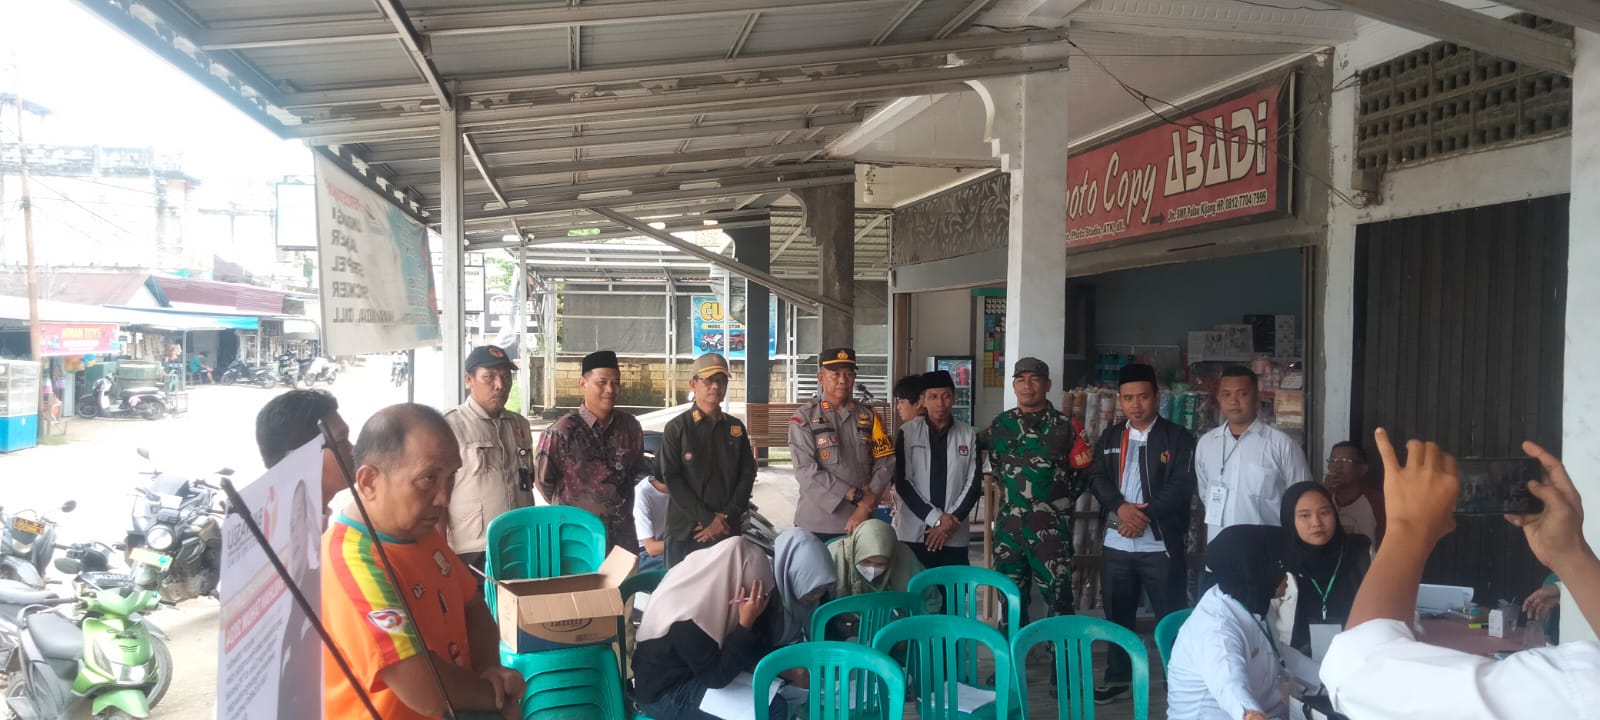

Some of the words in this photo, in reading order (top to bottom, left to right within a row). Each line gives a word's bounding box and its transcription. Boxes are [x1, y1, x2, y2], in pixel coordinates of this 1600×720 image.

[1103, 151, 1157, 225] Copy
[1187, 205, 1200, 218] Pulau
[1200, 201, 1216, 217] Kijang
[1071, 228, 1085, 240] Photo
[84, 327, 101, 338] TOYS
